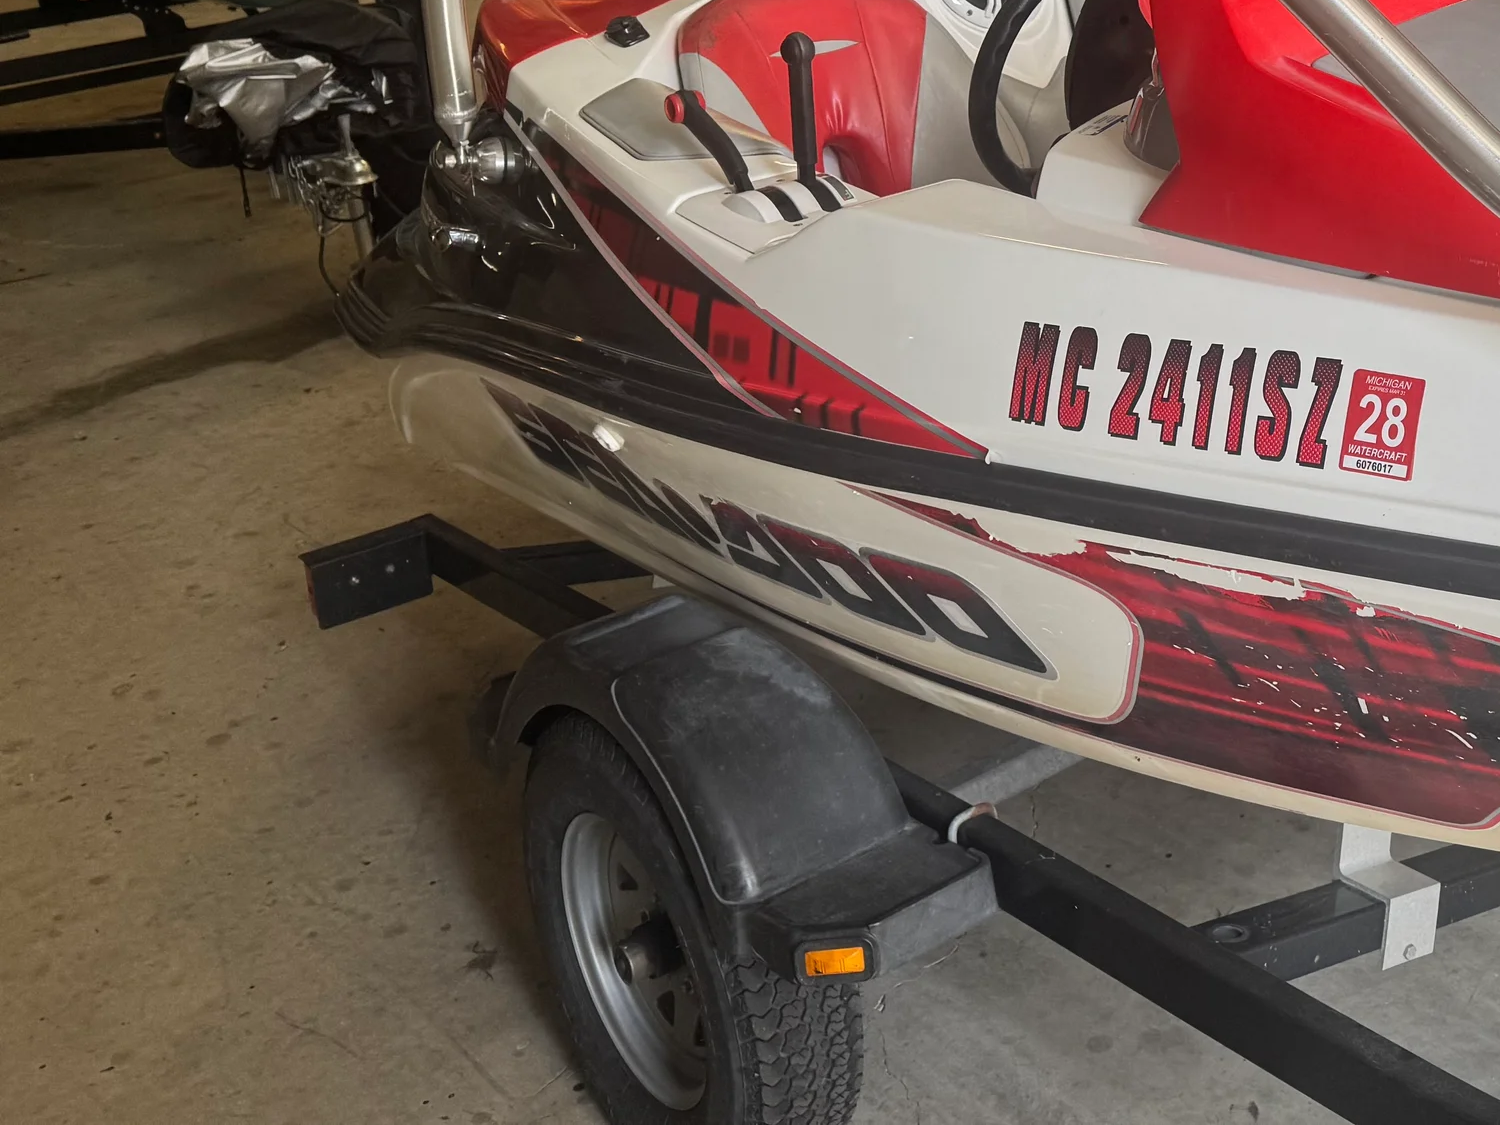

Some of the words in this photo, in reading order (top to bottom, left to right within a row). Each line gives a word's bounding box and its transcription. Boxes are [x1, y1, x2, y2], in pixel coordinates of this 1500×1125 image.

[1365, 376, 1412, 390] MICHIGAN
[1009, 321, 1099, 432] MC
[1107, 332, 1343, 470] 2411SZ
[1353, 394, 1407, 447] 28
[1348, 443, 1407, 462] WATERCRAFT
[1355, 459, 1394, 474] 6076017
